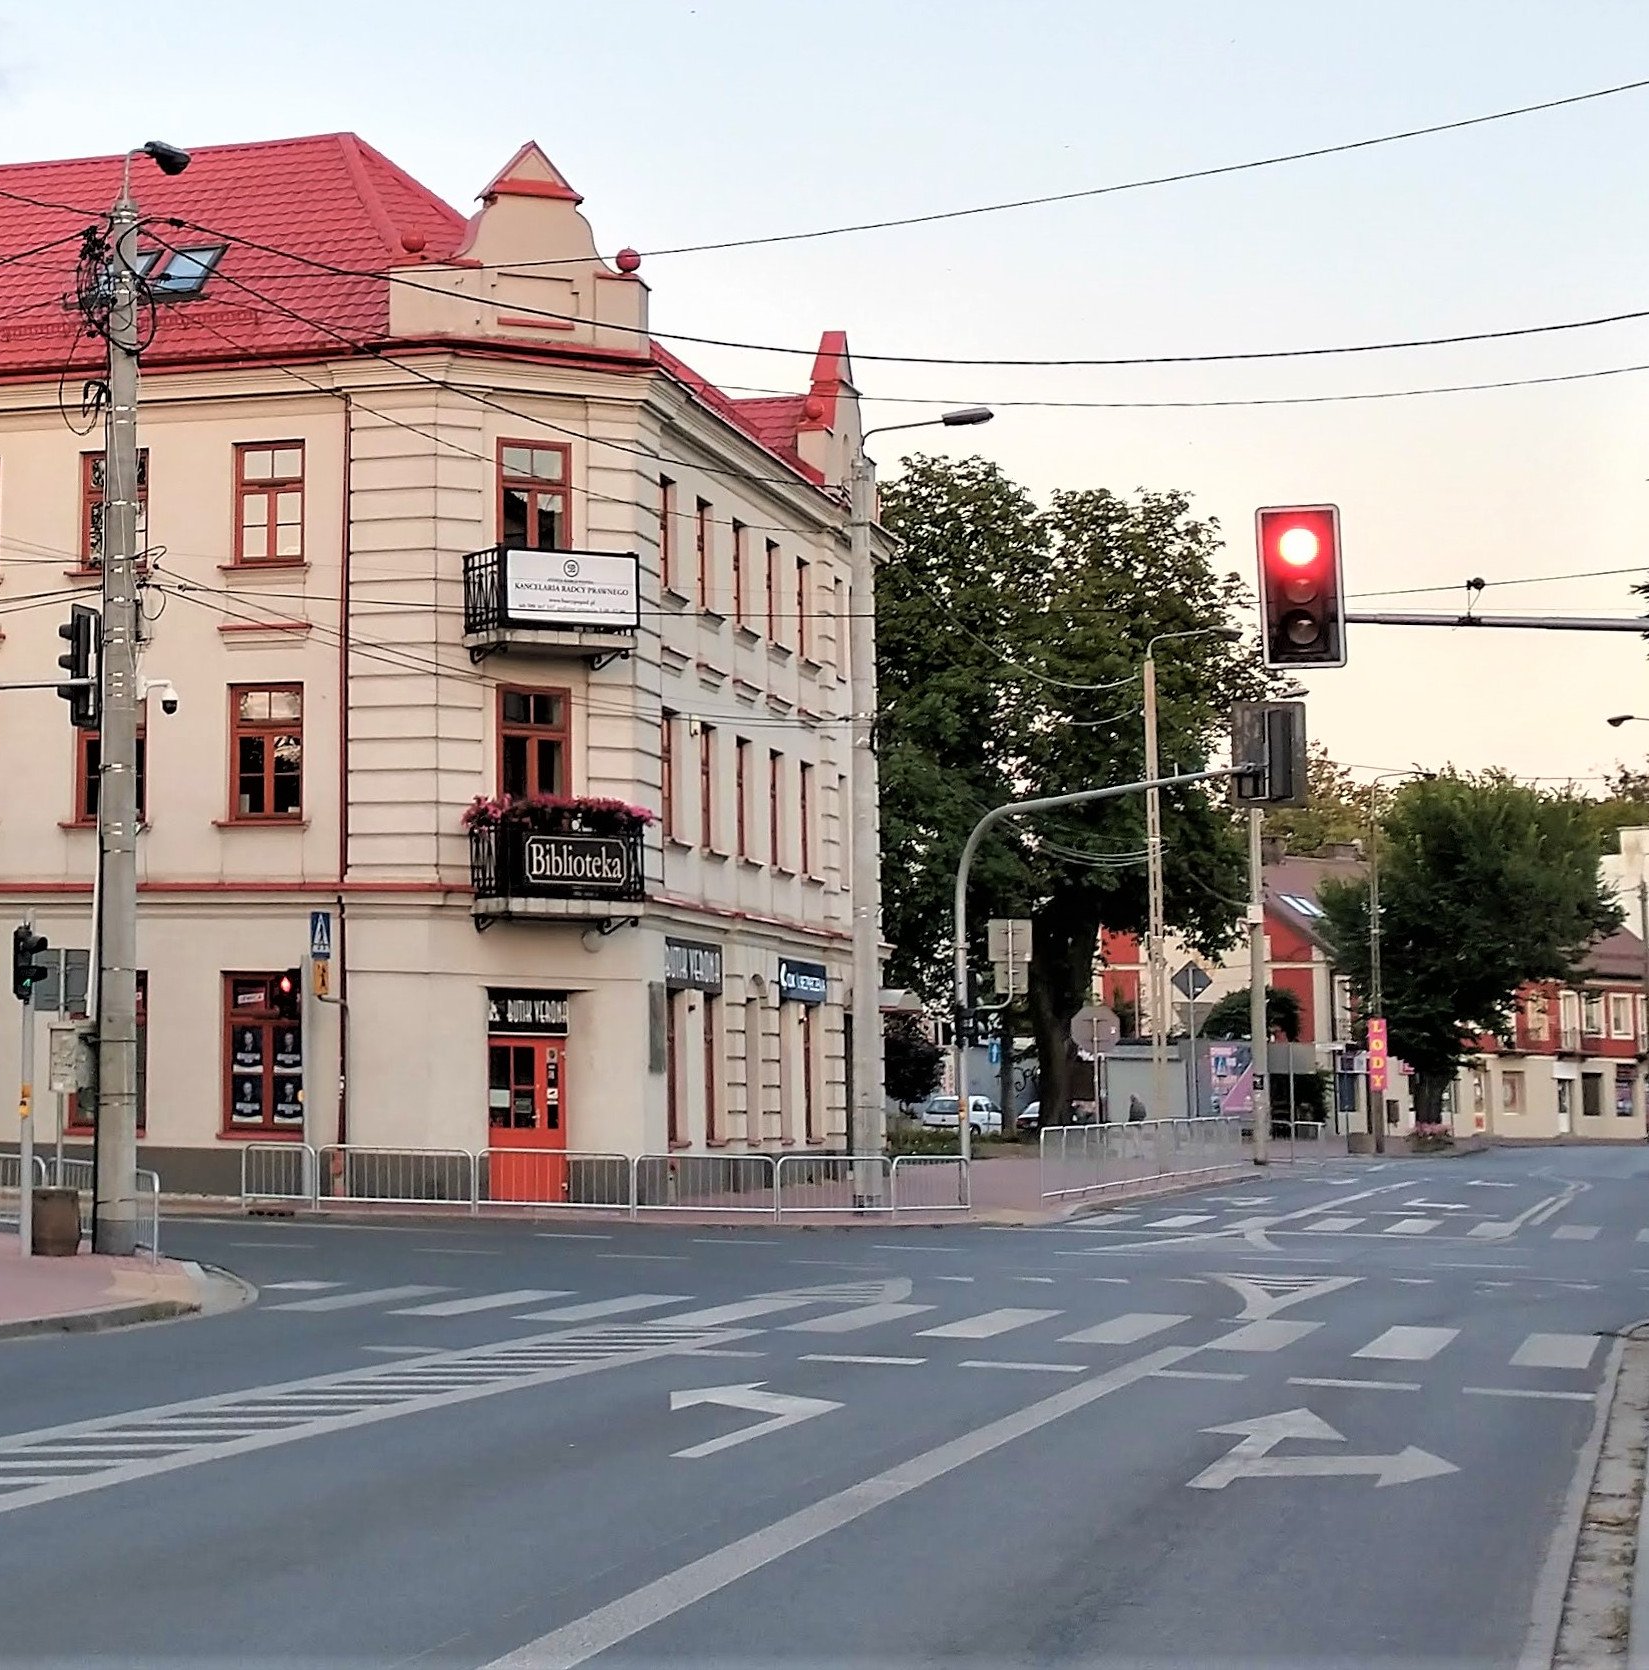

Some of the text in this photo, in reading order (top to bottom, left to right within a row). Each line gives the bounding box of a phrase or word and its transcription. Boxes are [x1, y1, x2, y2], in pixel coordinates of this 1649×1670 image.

[514, 582, 629, 596] KANCELARIA RADCY PRAWNEGO
[530, 843, 623, 879] Biblioteka
[1372, 1020, 1385, 1087] LODY
